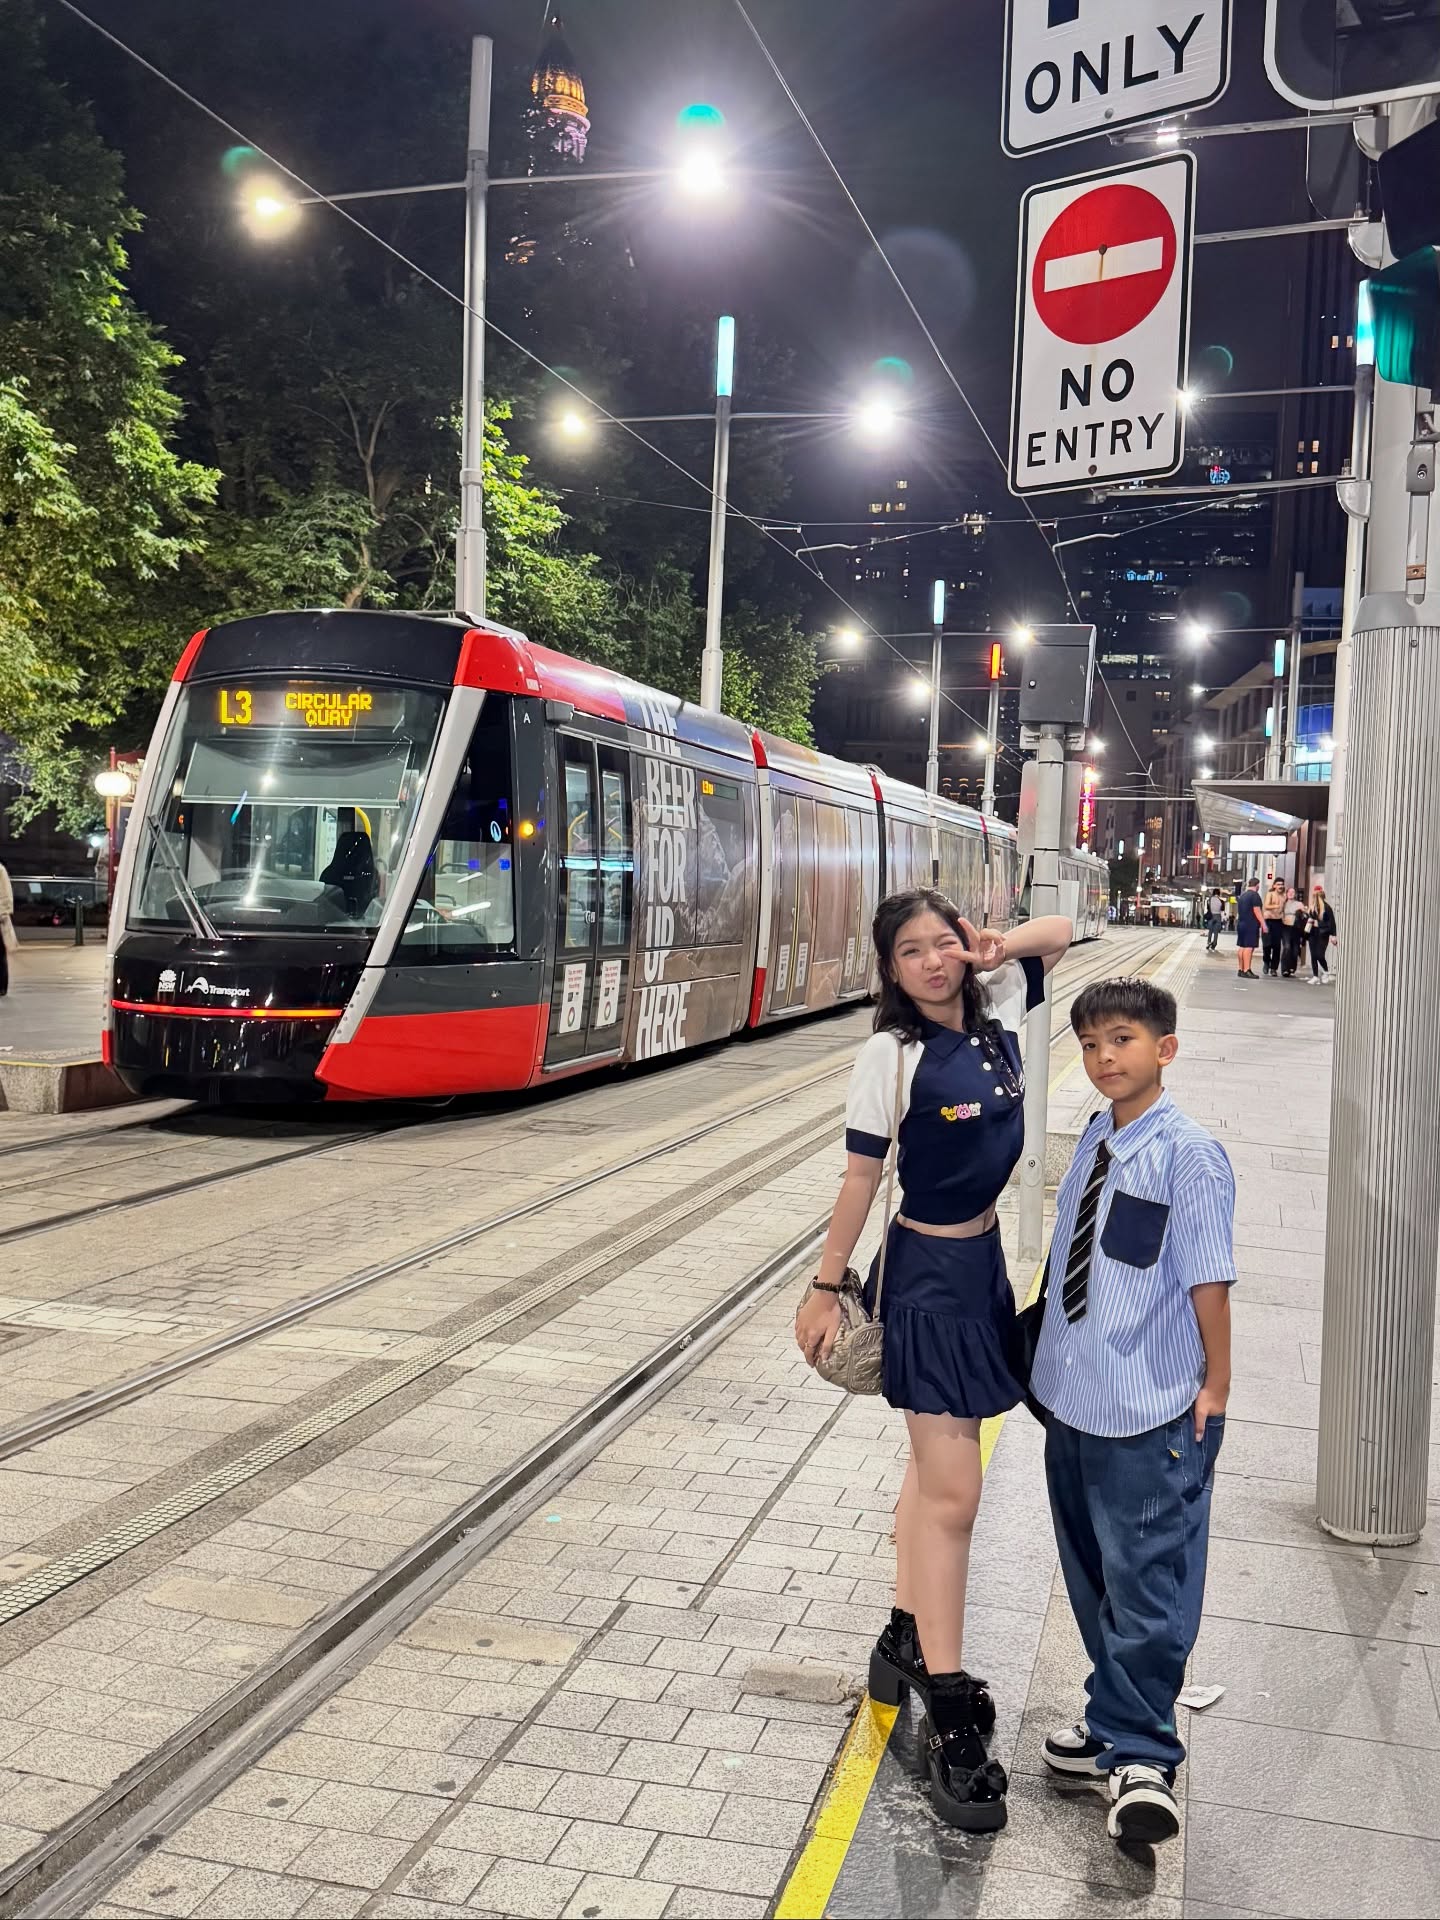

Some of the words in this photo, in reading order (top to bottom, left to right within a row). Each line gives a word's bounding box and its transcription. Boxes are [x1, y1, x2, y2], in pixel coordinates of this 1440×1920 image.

[1025, 13, 1204, 114] ONLY
[1060, 359, 1134, 410] NO
[1027, 413, 1164, 467] ENTRY
[220, 690, 252, 724] L3
[285, 693, 372, 710] CIRCULAR
[305, 710, 352, 727] QUAY
[523, 712, 531, 724] A
[645, 757, 697, 830] BEER
[647, 827, 687, 903] FOR
[644, 905, 674, 984] UP
[209, 985, 250, 997] Transport
[635, 981, 691, 1061] HERE
